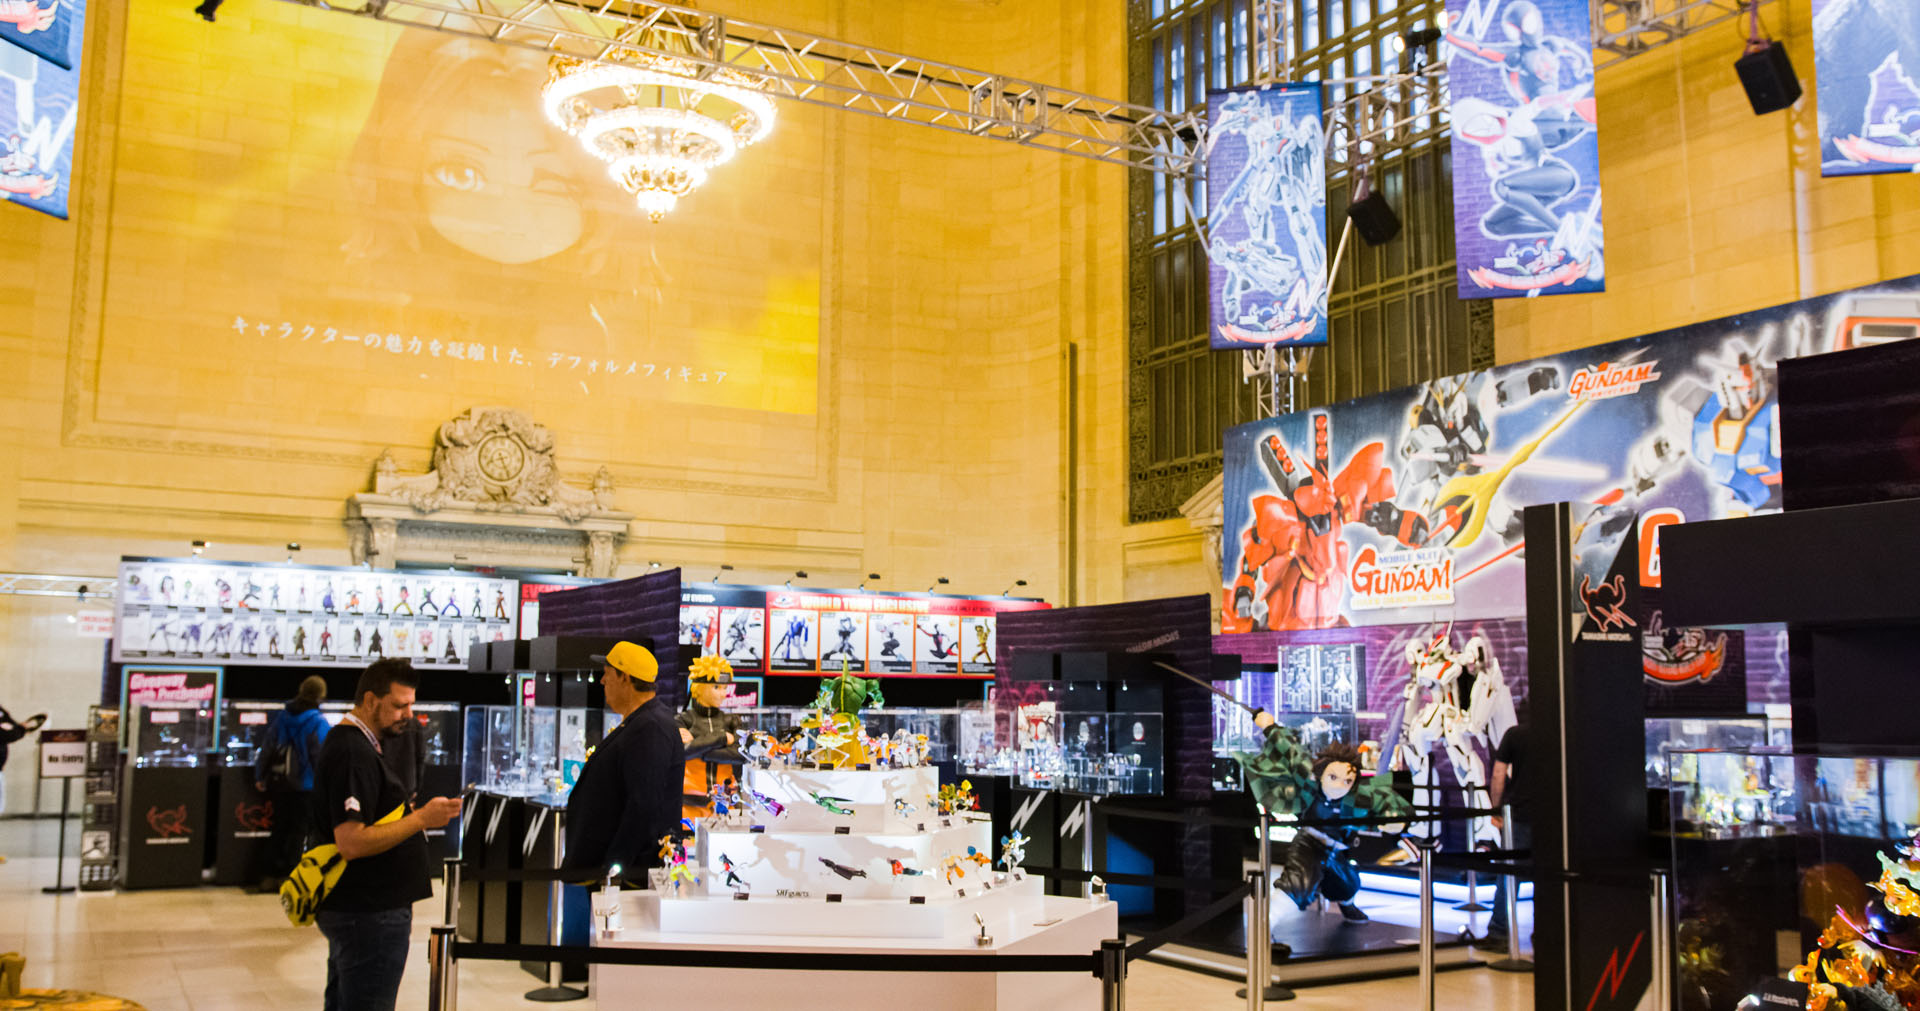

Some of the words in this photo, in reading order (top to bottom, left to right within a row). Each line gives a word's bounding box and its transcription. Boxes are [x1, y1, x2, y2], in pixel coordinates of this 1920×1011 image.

[1569, 363, 1656, 400] GUNDAM
[1351, 547, 1451, 597] GUNDAM
[800, 595, 841, 609] WORLD
[129, 673, 188, 691] Giveaway
